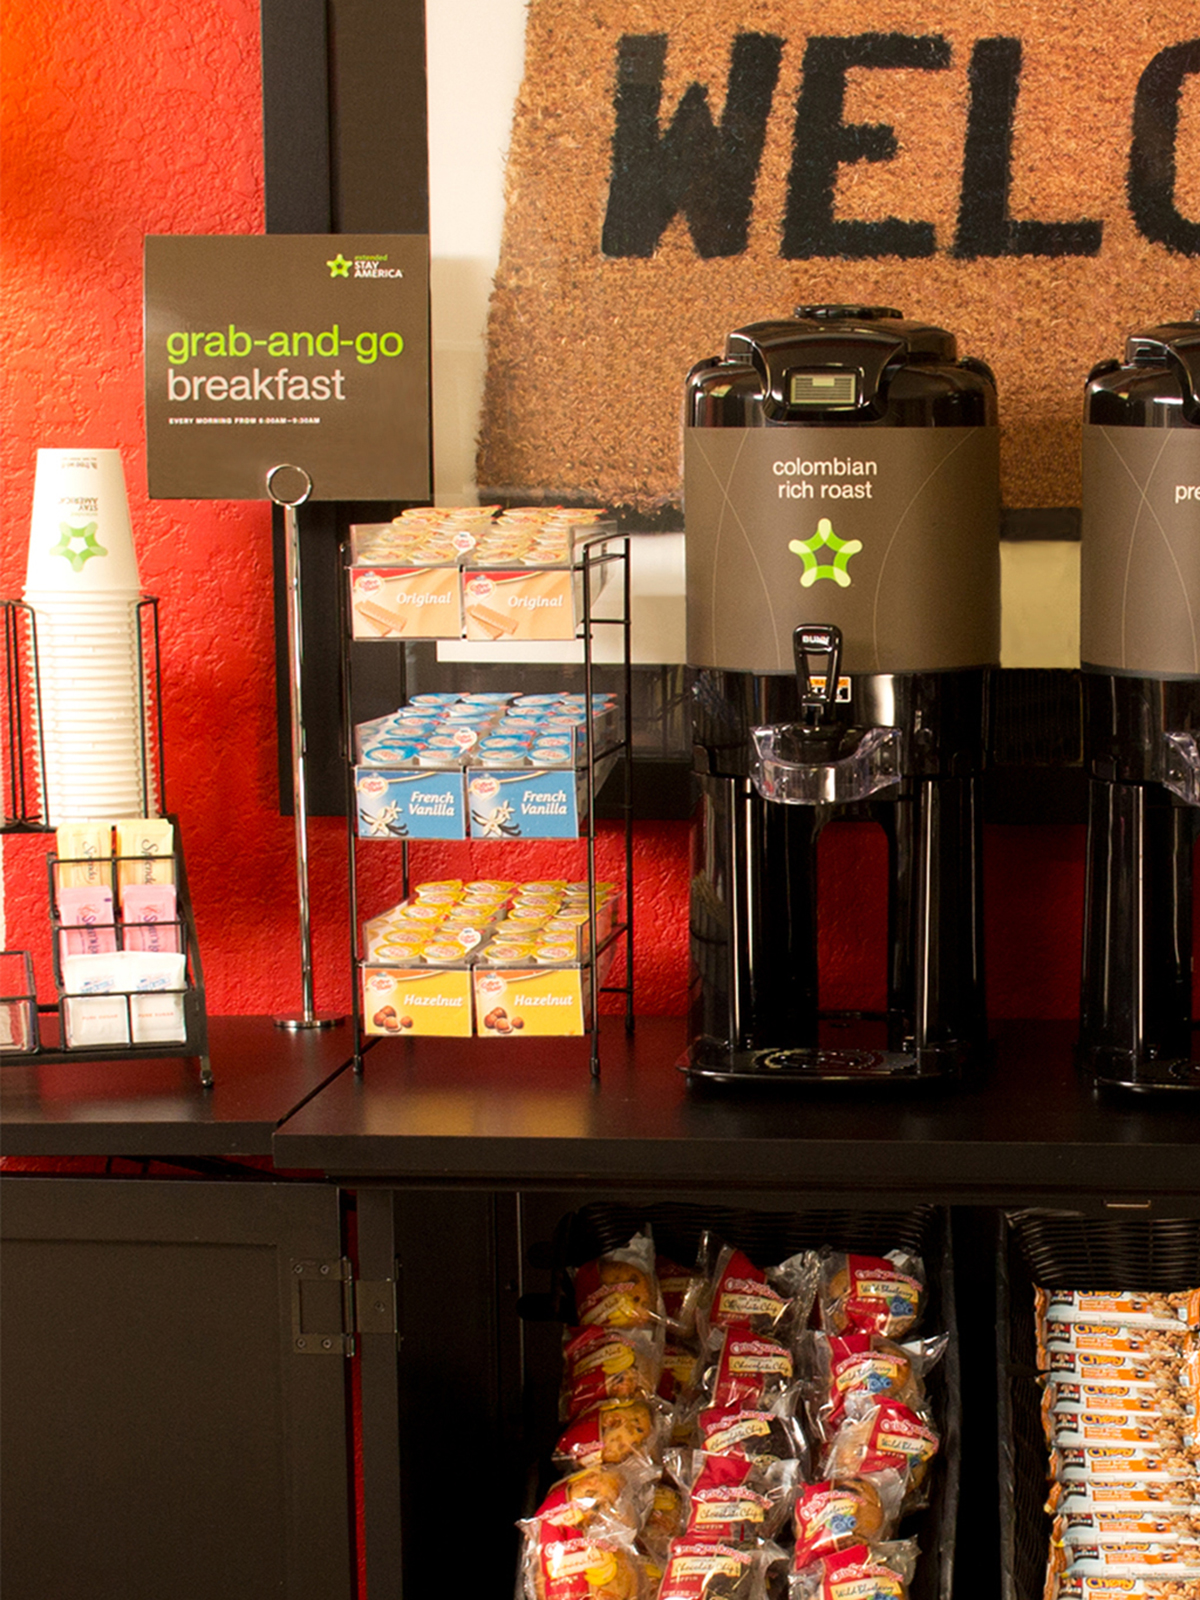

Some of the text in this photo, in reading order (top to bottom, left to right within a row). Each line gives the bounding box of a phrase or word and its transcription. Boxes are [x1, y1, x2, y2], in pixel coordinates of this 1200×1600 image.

[354, 261, 380, 269] STAY
[354, 269, 403, 278] AMERICA
[166, 324, 404, 364] grab-and-go
[168, 368, 346, 401] breakfast
[168, 417, 194, 425] EVERY
[195, 417, 232, 425] MORNING
[234, 417, 257, 425] FROM
[772, 457, 877, 476] colombian
[778, 480, 873, 499] rich roast
[396, 592, 451, 607] Original
[508, 595, 563, 611] Original
[410, 791, 454, 803] French
[523, 790, 567, 802] French
[408, 803, 455, 817] Vanilla
[520, 802, 567, 815] Vanilla
[403, 994, 463, 1007] Hazelnut
[514, 994, 574, 1007] Hazelnut
[1079, 1353, 1125, 1367] Chewy
[1087, 1577, 1135, 1590] Chewy
